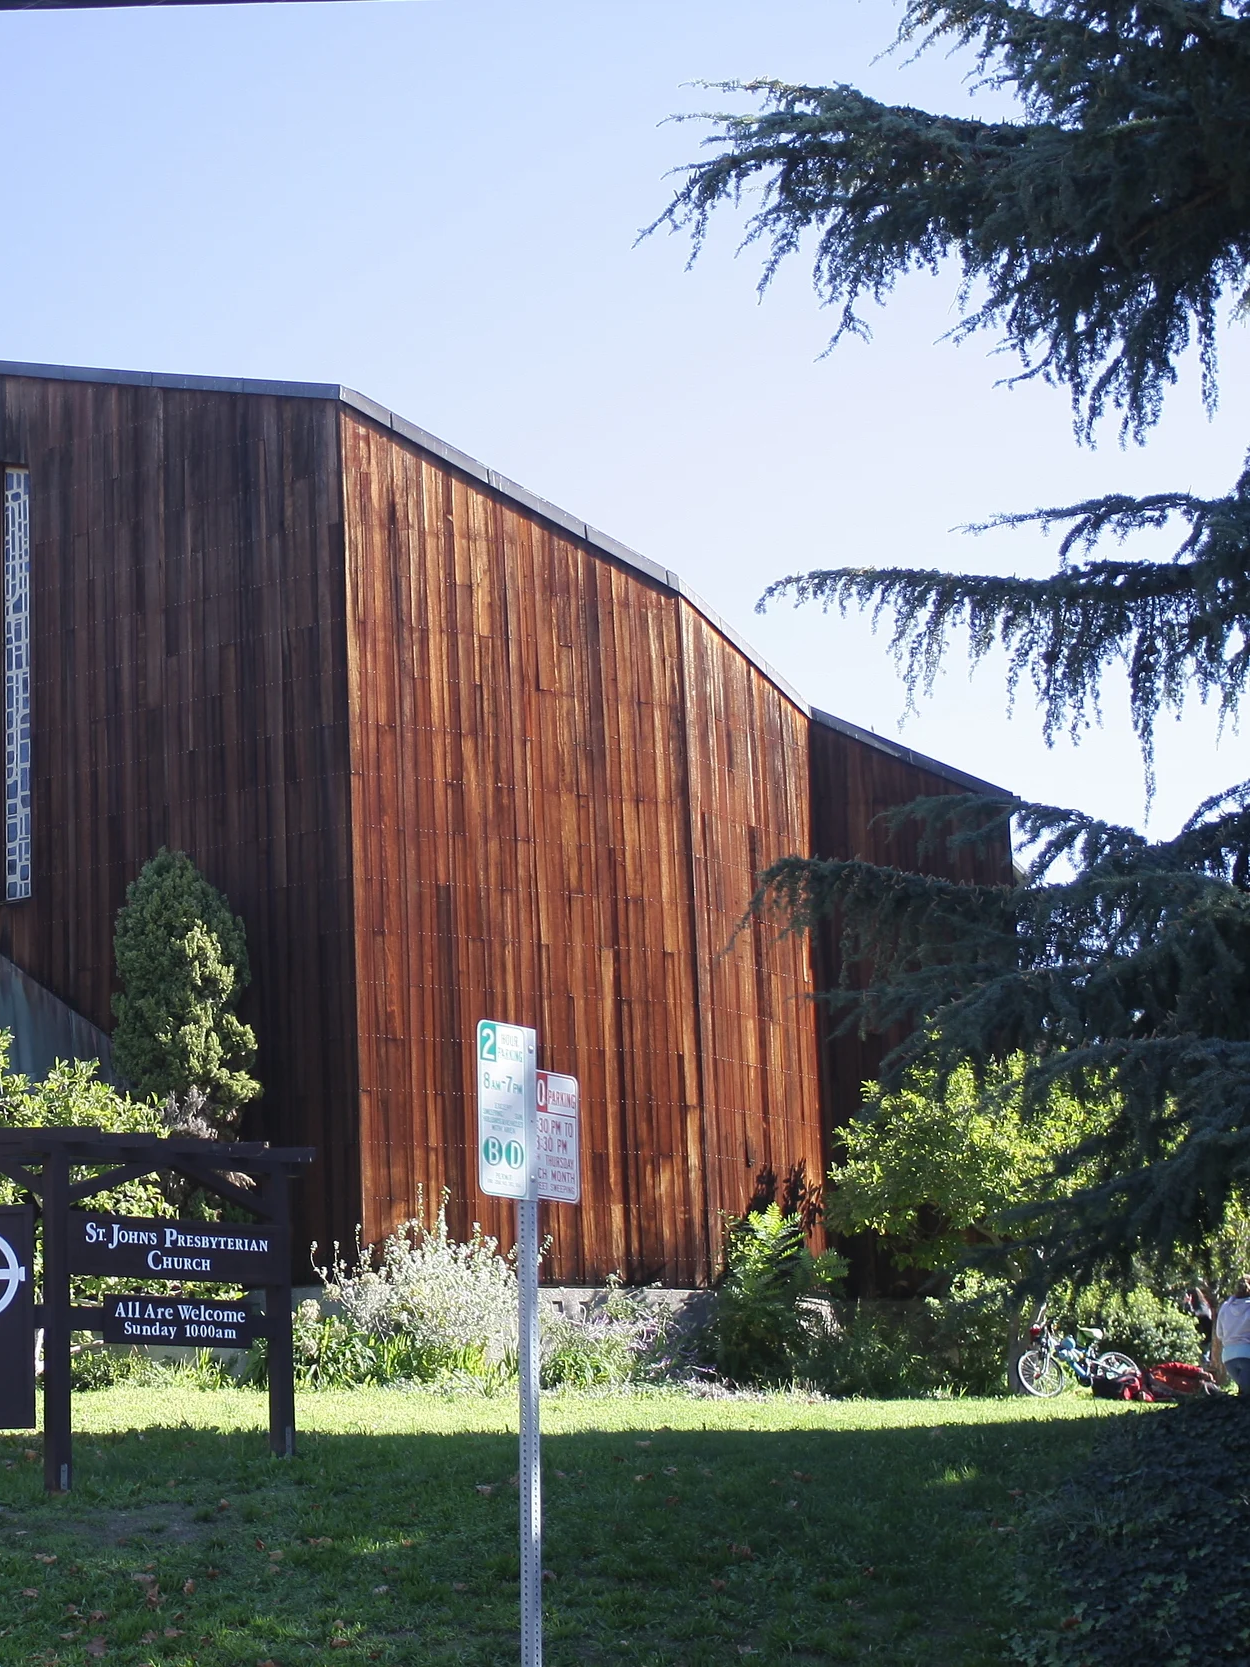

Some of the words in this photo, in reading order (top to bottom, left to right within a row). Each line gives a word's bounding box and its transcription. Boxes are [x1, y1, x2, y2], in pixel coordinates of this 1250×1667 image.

[481, 1028, 495, 1060] 2
[547, 1089, 576, 1110] PARKING
[564, 1122, 574, 1138] TO
[488, 1137, 500, 1164] B
[557, 1139, 568, 1155] PM
[537, 1167, 548, 1179] CH
[550, 1169, 575, 1184] MONTH
[163, 1228, 268, 1252] PRESBYTERIAN
[147, 1250, 211, 1271] CHURCH
[114, 1301, 141, 1318] All
[144, 1303, 174, 1320] Are
[177, 1304, 246, 1323] Welcome
[123, 1321, 177, 1339] Sunday
